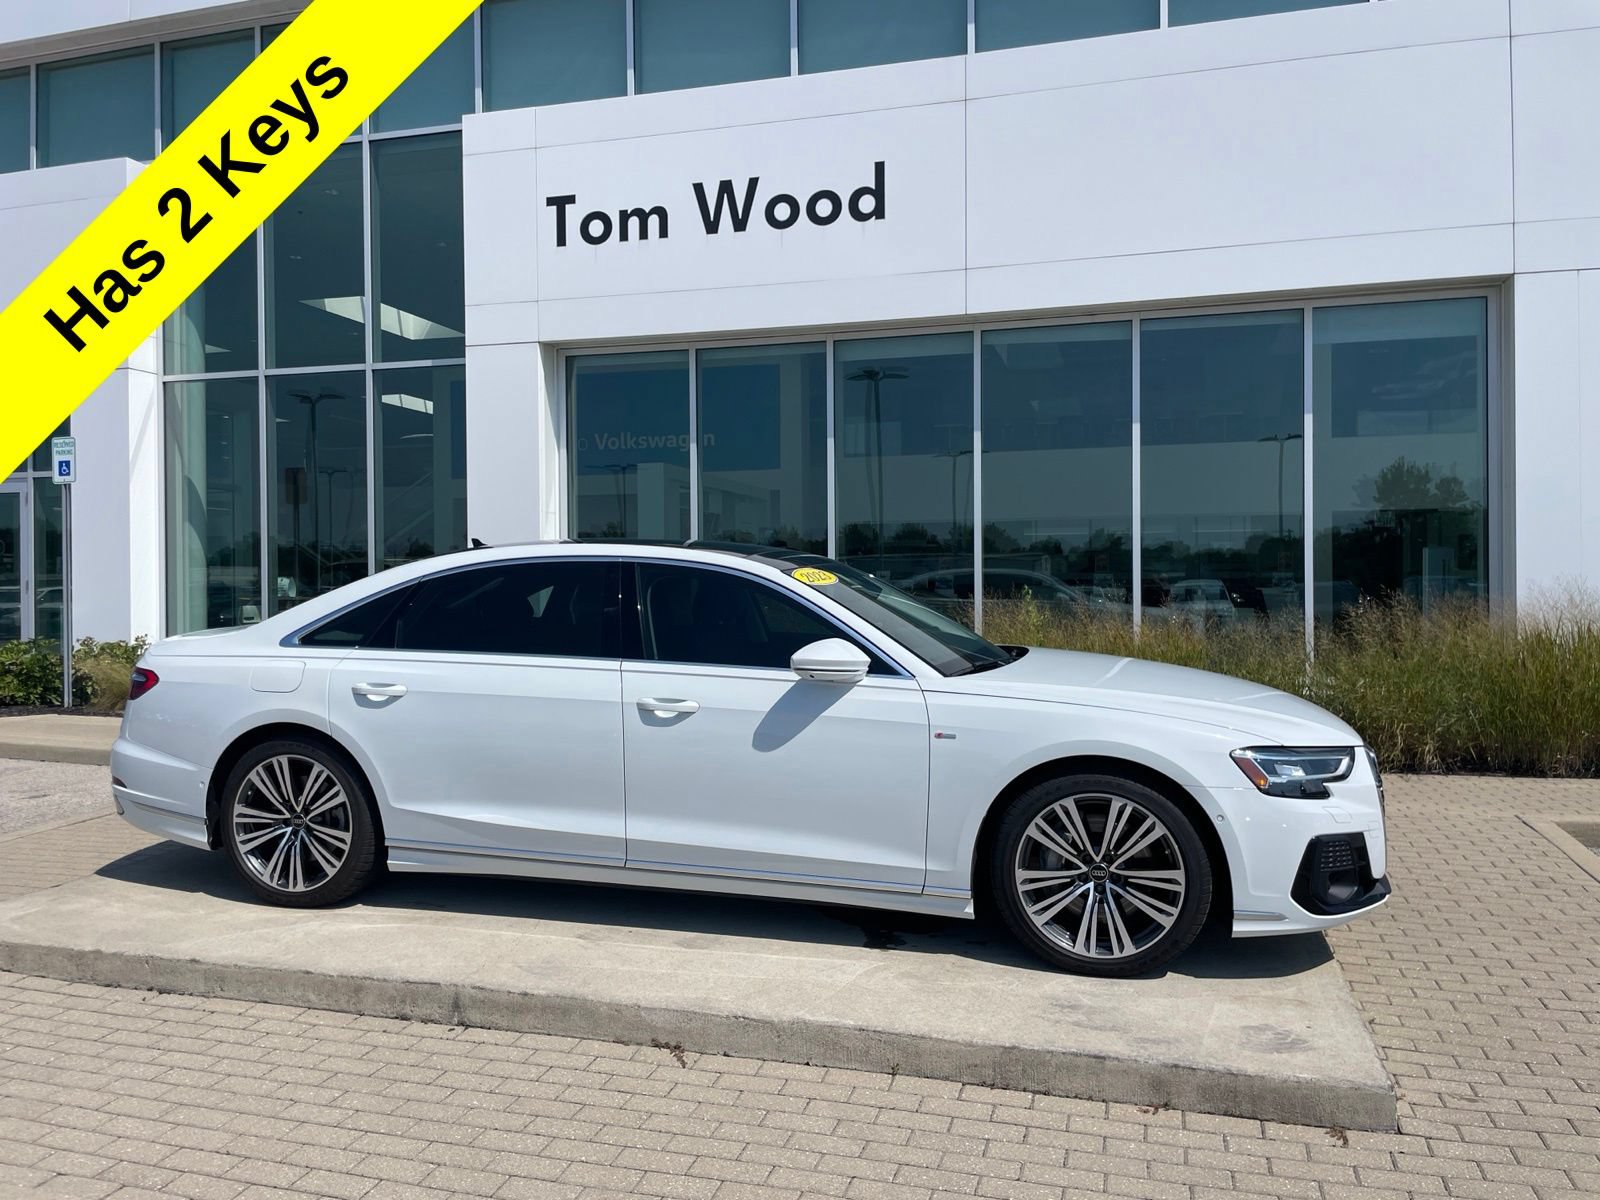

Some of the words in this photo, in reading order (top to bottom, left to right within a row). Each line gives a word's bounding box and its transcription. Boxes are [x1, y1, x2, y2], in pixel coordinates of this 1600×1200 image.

[546, 194, 669, 247] Tom
[692, 161, 886, 235] Wood
[594, 432, 715, 452] Volkswagn
